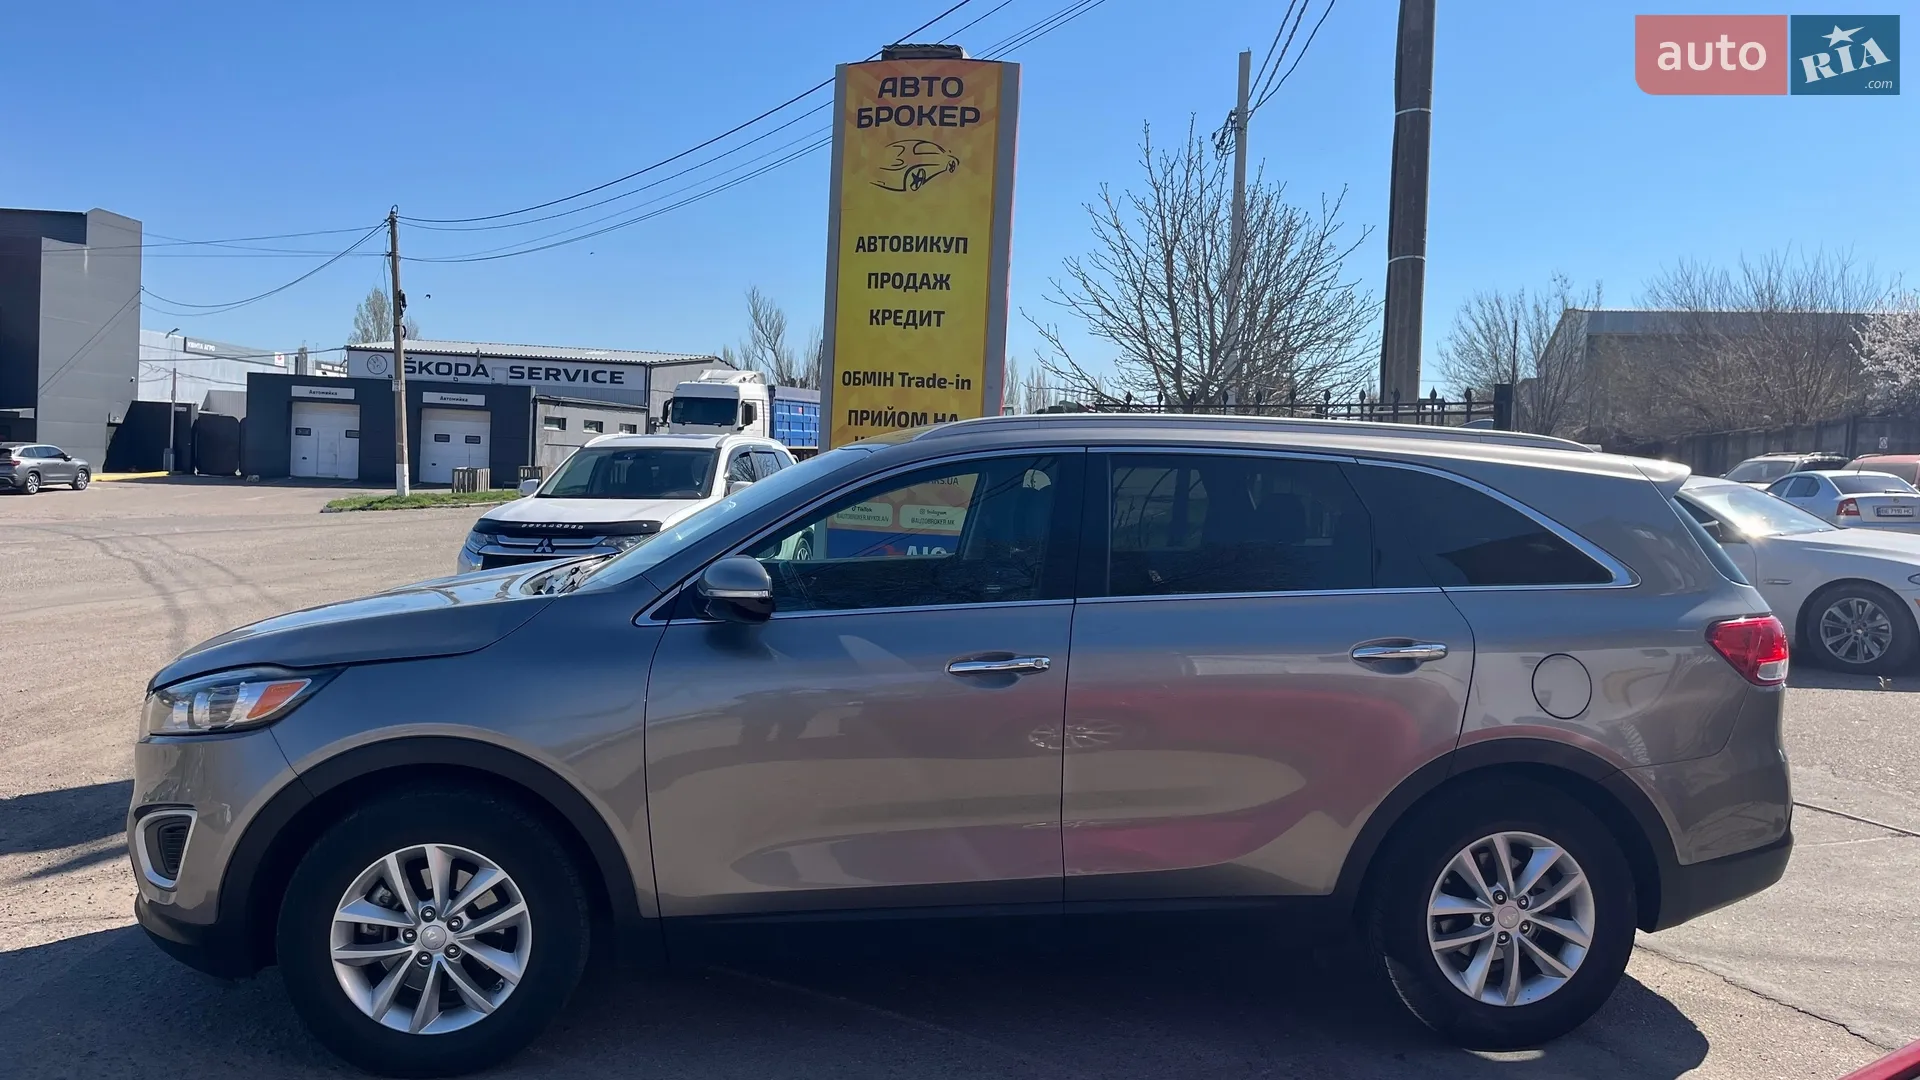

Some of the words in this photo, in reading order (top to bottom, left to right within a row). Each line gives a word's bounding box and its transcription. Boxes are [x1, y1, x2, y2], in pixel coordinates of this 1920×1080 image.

[878, 76, 964, 98] АВТО
[857, 105, 981, 128] БРОКЕР
[855, 235, 968, 254] АВТОВИКУП
[867, 272, 951, 292] ПРОДАЖ
[869, 309, 945, 329] КРЕДИТ
[404, 357, 490, 378] ŠKODA
[509, 365, 625, 385] SERVICE
[842, 371, 894, 387] ОБМІН
[898, 372, 971, 390] Trade-in
[848, 406, 928, 427] ПРИЙОМ
